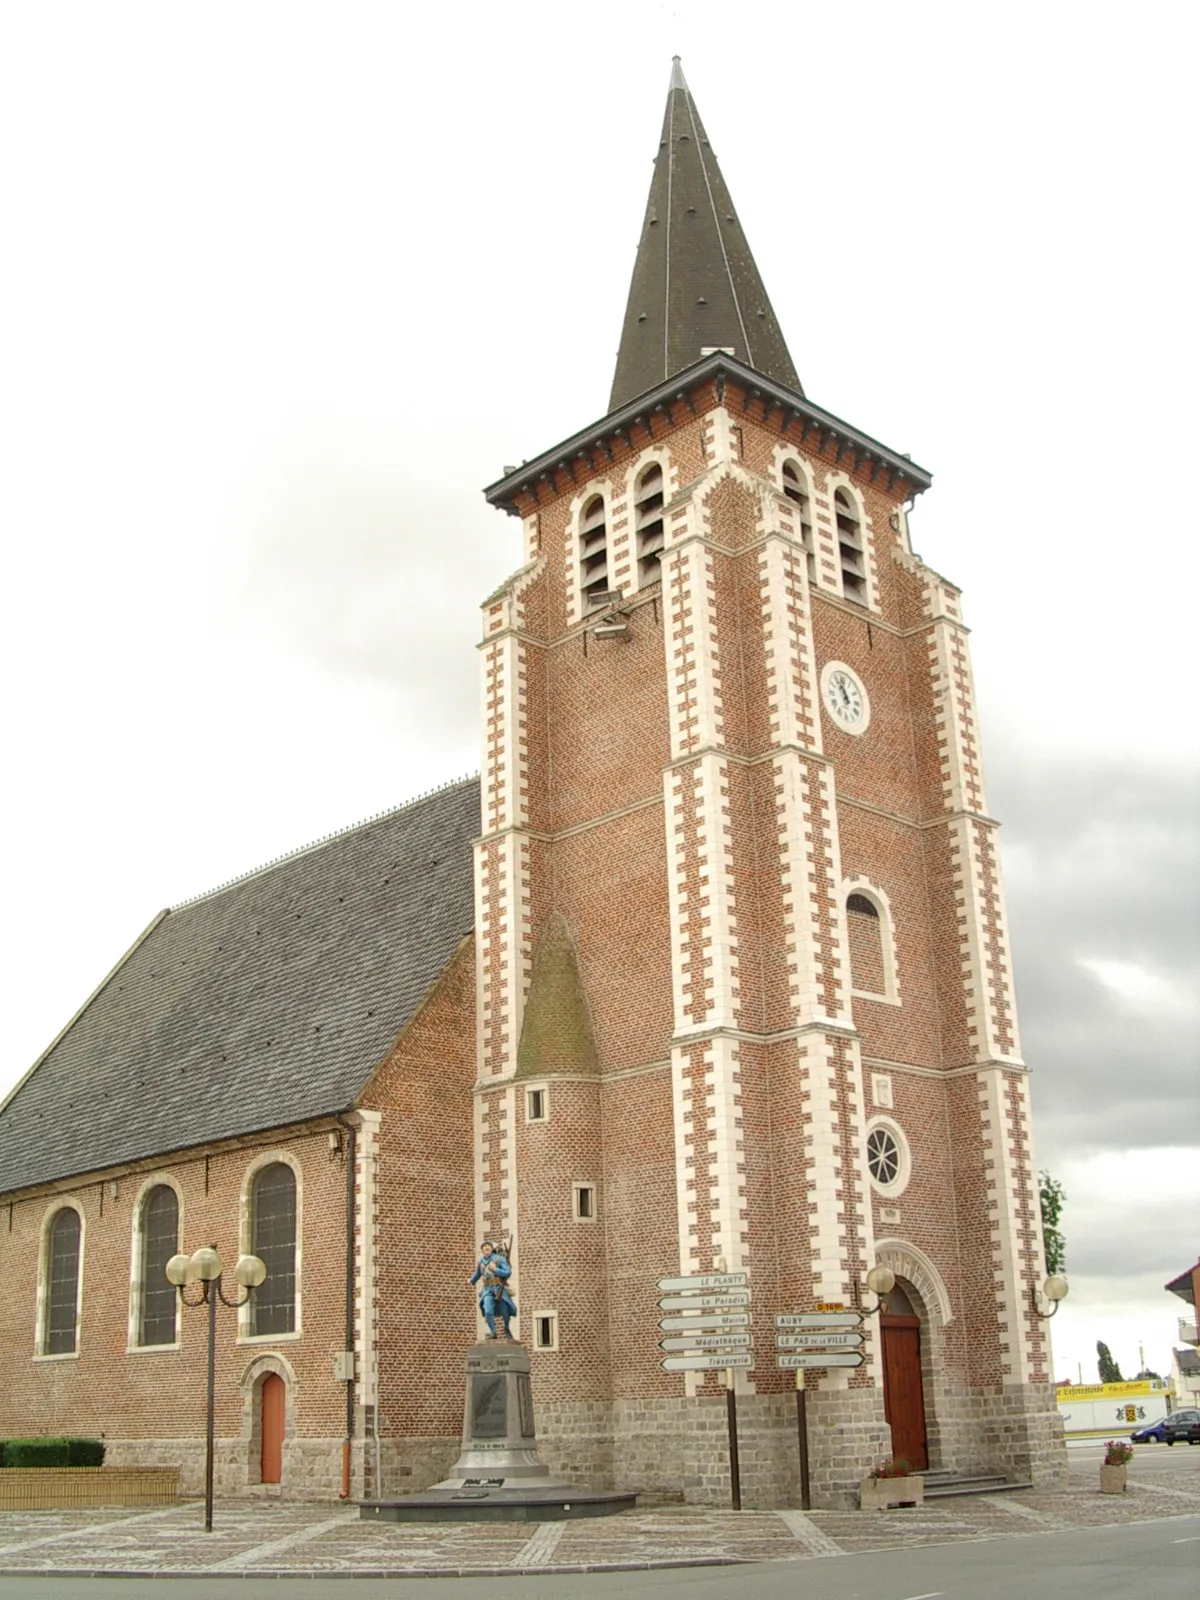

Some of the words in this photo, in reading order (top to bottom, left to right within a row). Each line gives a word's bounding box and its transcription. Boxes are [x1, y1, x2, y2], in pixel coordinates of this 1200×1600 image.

[701, 1277, 710, 1286] LE
[713, 1275, 743, 1285] PLANTY
[714, 1295, 745, 1305] Paradis
[721, 1315, 746, 1325] Mairie
[780, 1317, 803, 1325] AUBY
[695, 1335, 747, 1347] Médiathèque
[780, 1336, 790, 1345] LE
[793, 1336, 809, 1345] PAS
[827, 1336, 848, 1344] VILLE
[708, 1355, 749, 1366] Trésorerie
